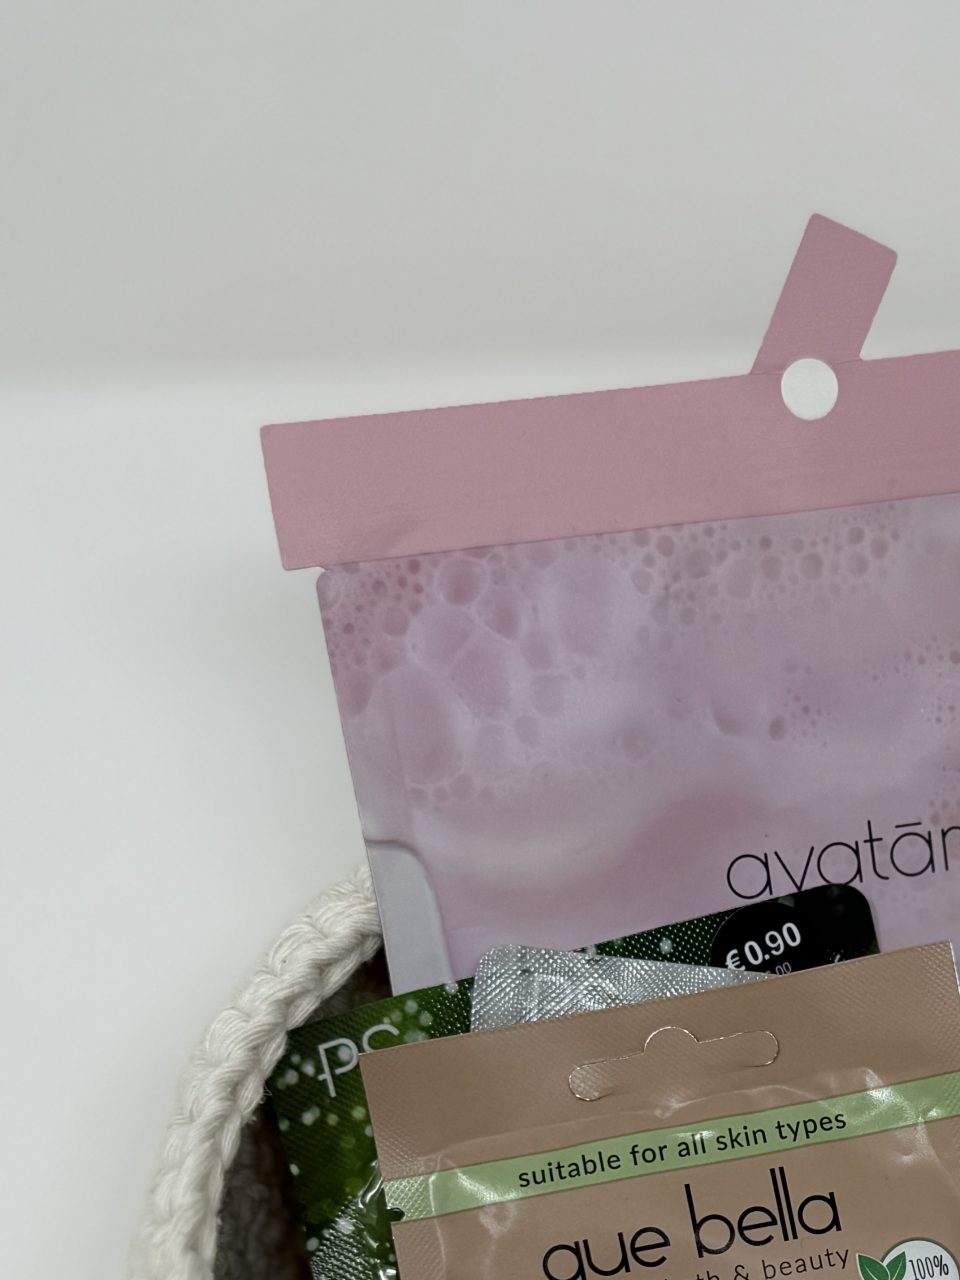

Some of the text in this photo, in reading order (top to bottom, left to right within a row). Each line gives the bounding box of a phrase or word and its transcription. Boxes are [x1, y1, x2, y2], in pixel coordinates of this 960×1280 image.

[518, 1112, 847, 1188] suitable for all skin types
[684, 1166, 843, 1259] bella
[761, 1248, 849, 1280] beauty
